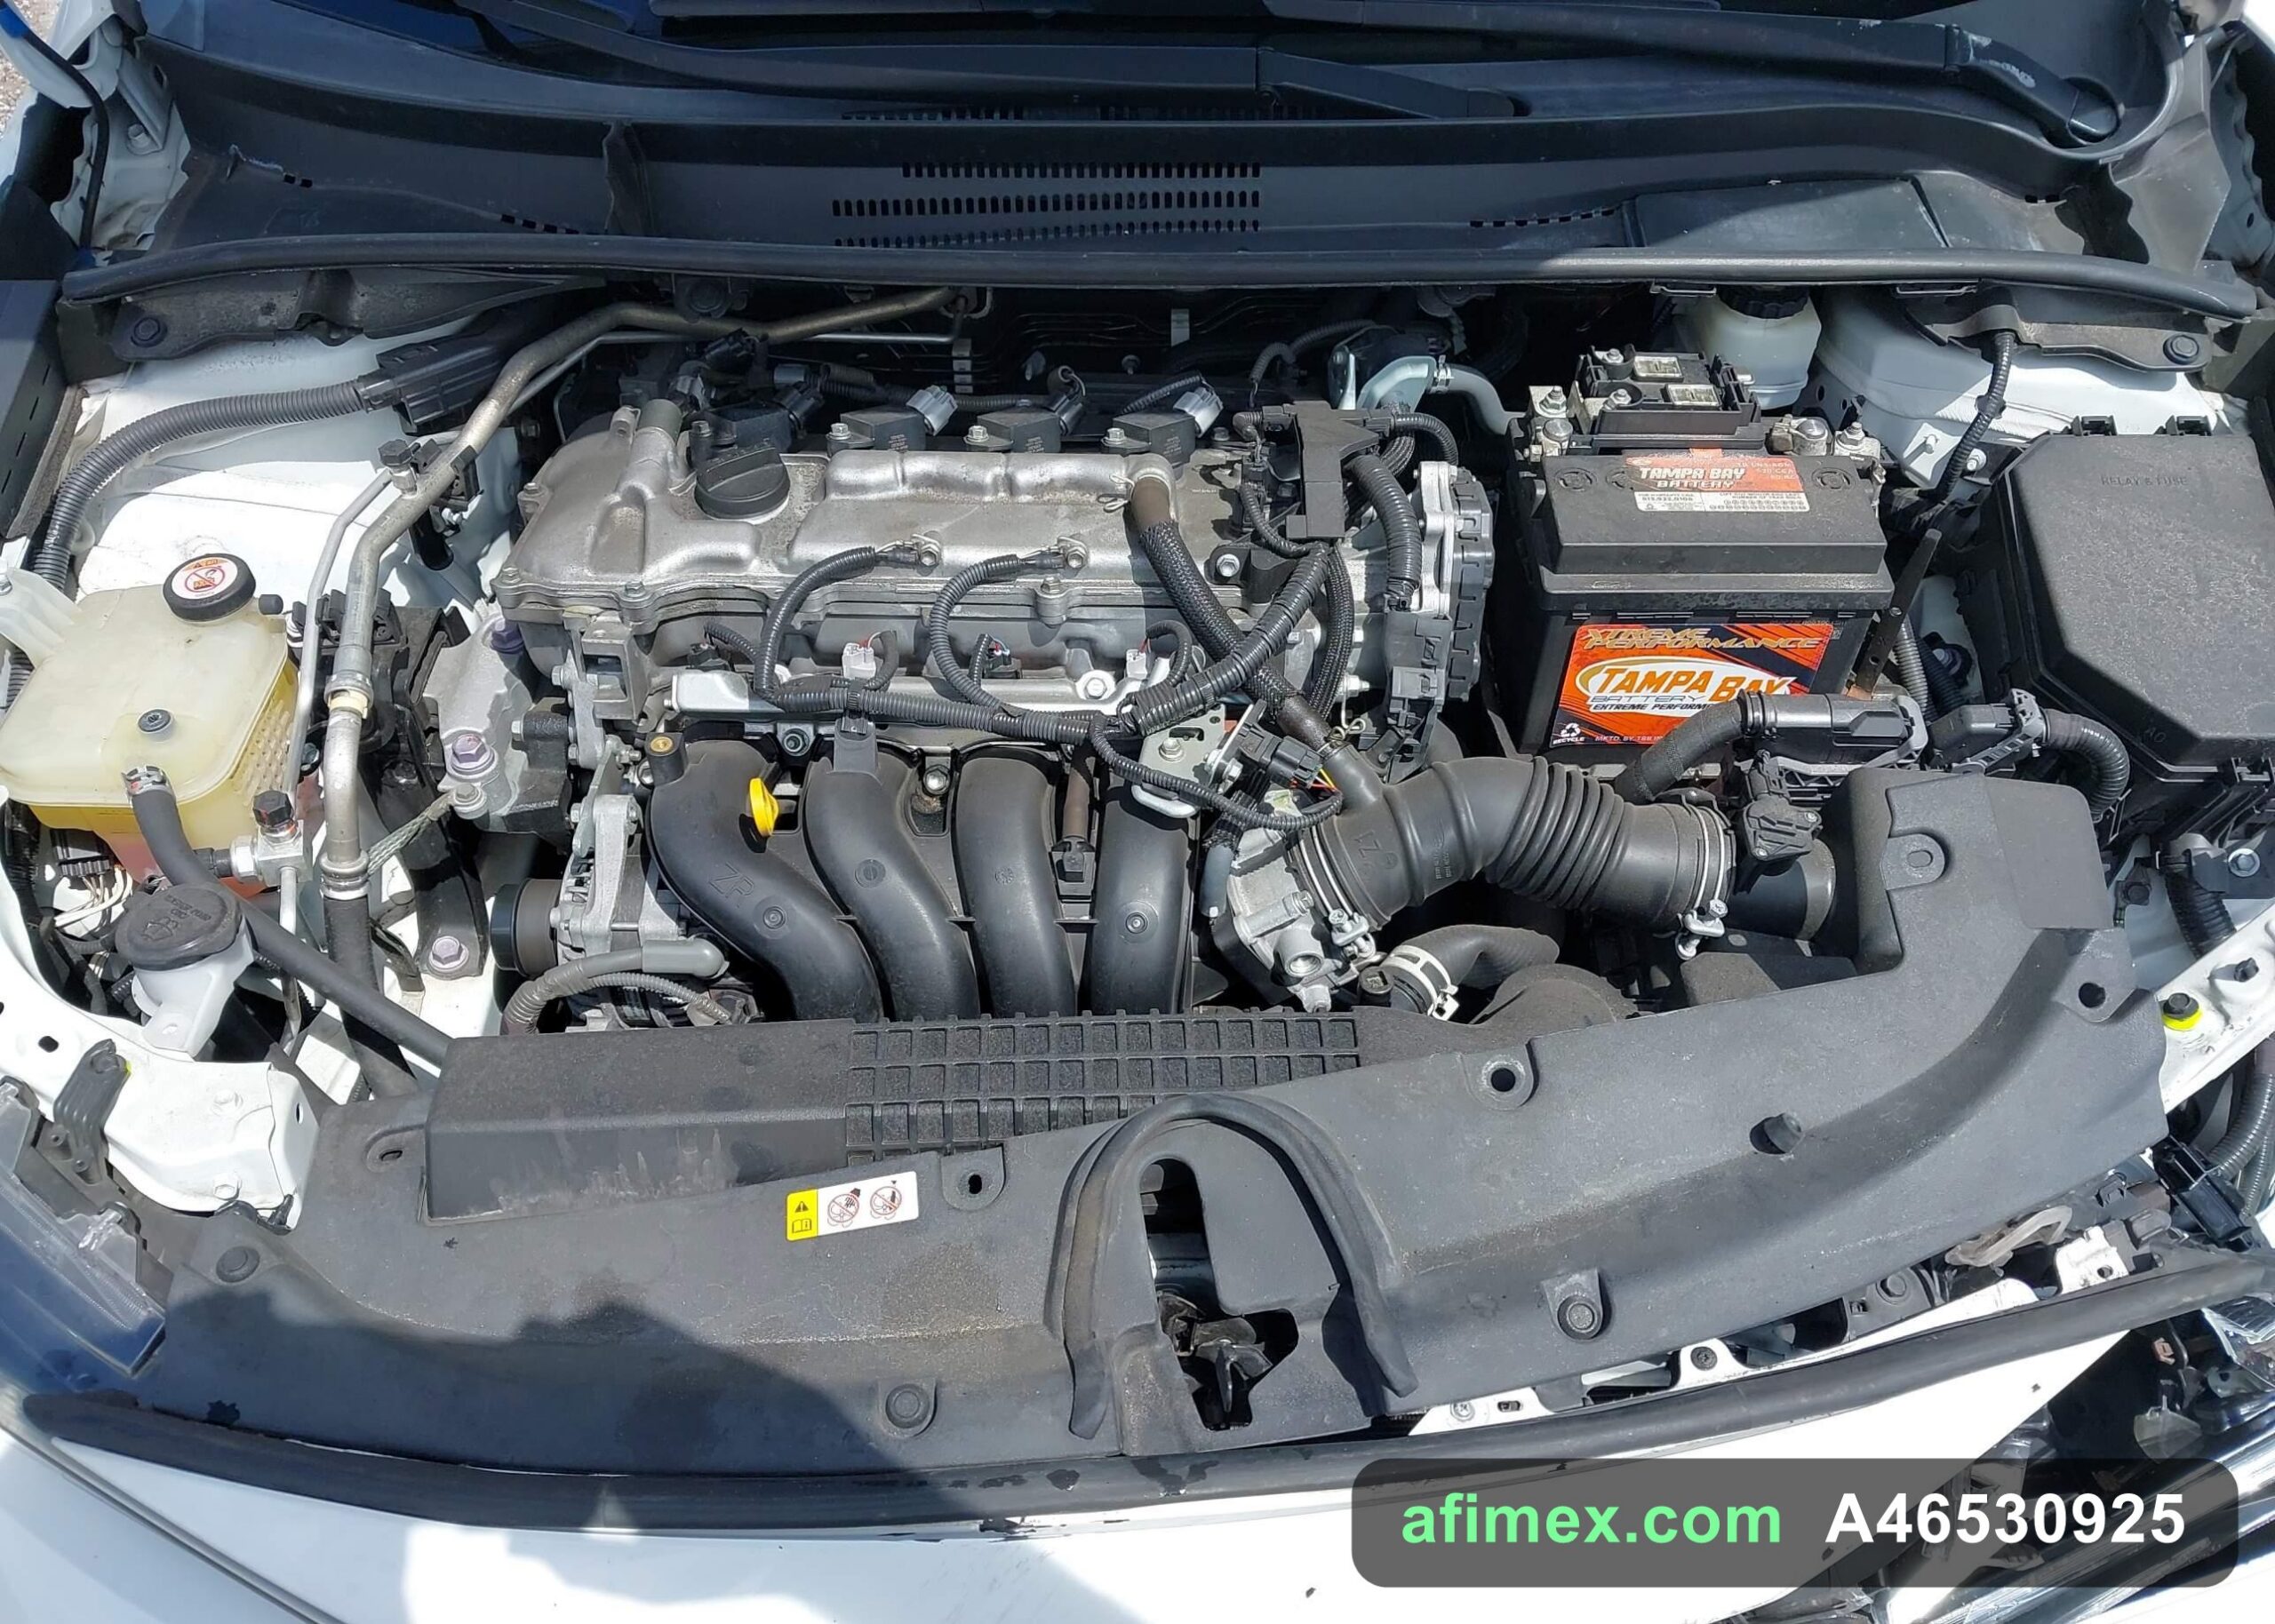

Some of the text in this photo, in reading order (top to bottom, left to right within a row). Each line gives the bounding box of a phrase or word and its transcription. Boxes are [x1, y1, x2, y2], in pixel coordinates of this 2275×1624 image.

[1639, 467, 1745, 480] TAMPA BAY
[1656, 480, 1735, 489] BATTERY
[1586, 628, 1711, 639] XTREME
[1584, 637, 1822, 649] PERFORMANCE
[1597, 668, 1791, 701] TAMPA BAY
